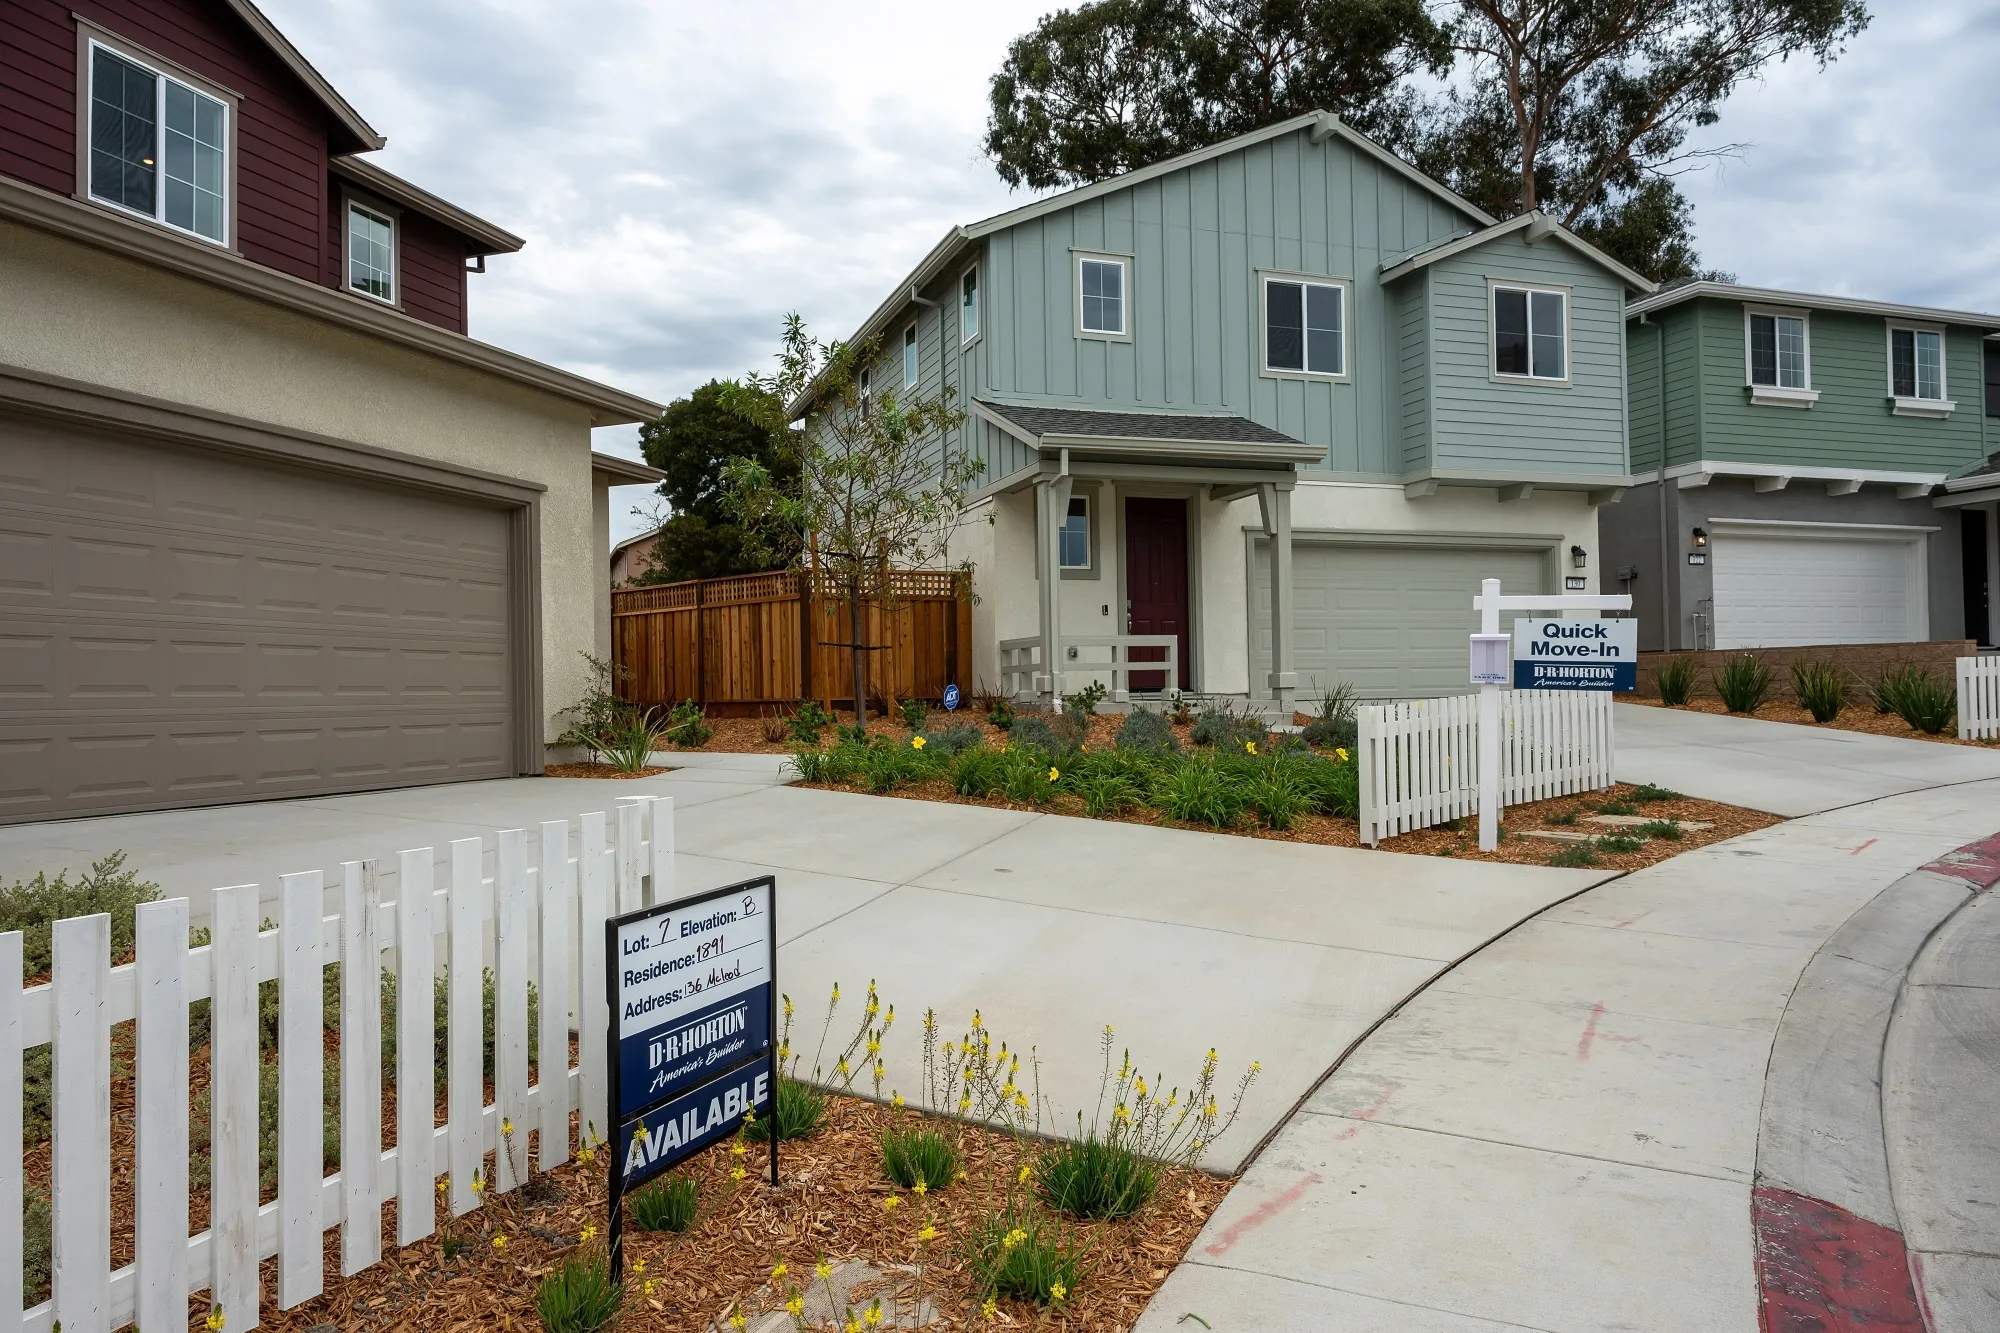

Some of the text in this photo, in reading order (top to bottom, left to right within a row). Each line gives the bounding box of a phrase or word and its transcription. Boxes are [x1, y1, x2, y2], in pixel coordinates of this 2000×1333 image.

[1531, 641, 1620, 657] Move-In
[1543, 623, 1608, 639] Quick
[946, 691, 957, 702] ADT
[1534, 679, 1614, 687] America's Builder
[623, 895, 756, 956] Lot: 7 Elevation: B
[623, 934, 725, 988] Residence: 1891
[623, 988, 683, 1021] Address:
[684, 979, 703, 996] 136
[649, 1038, 745, 1093] America's Builder
[623, 1070, 769, 1177] AVAILABLE
